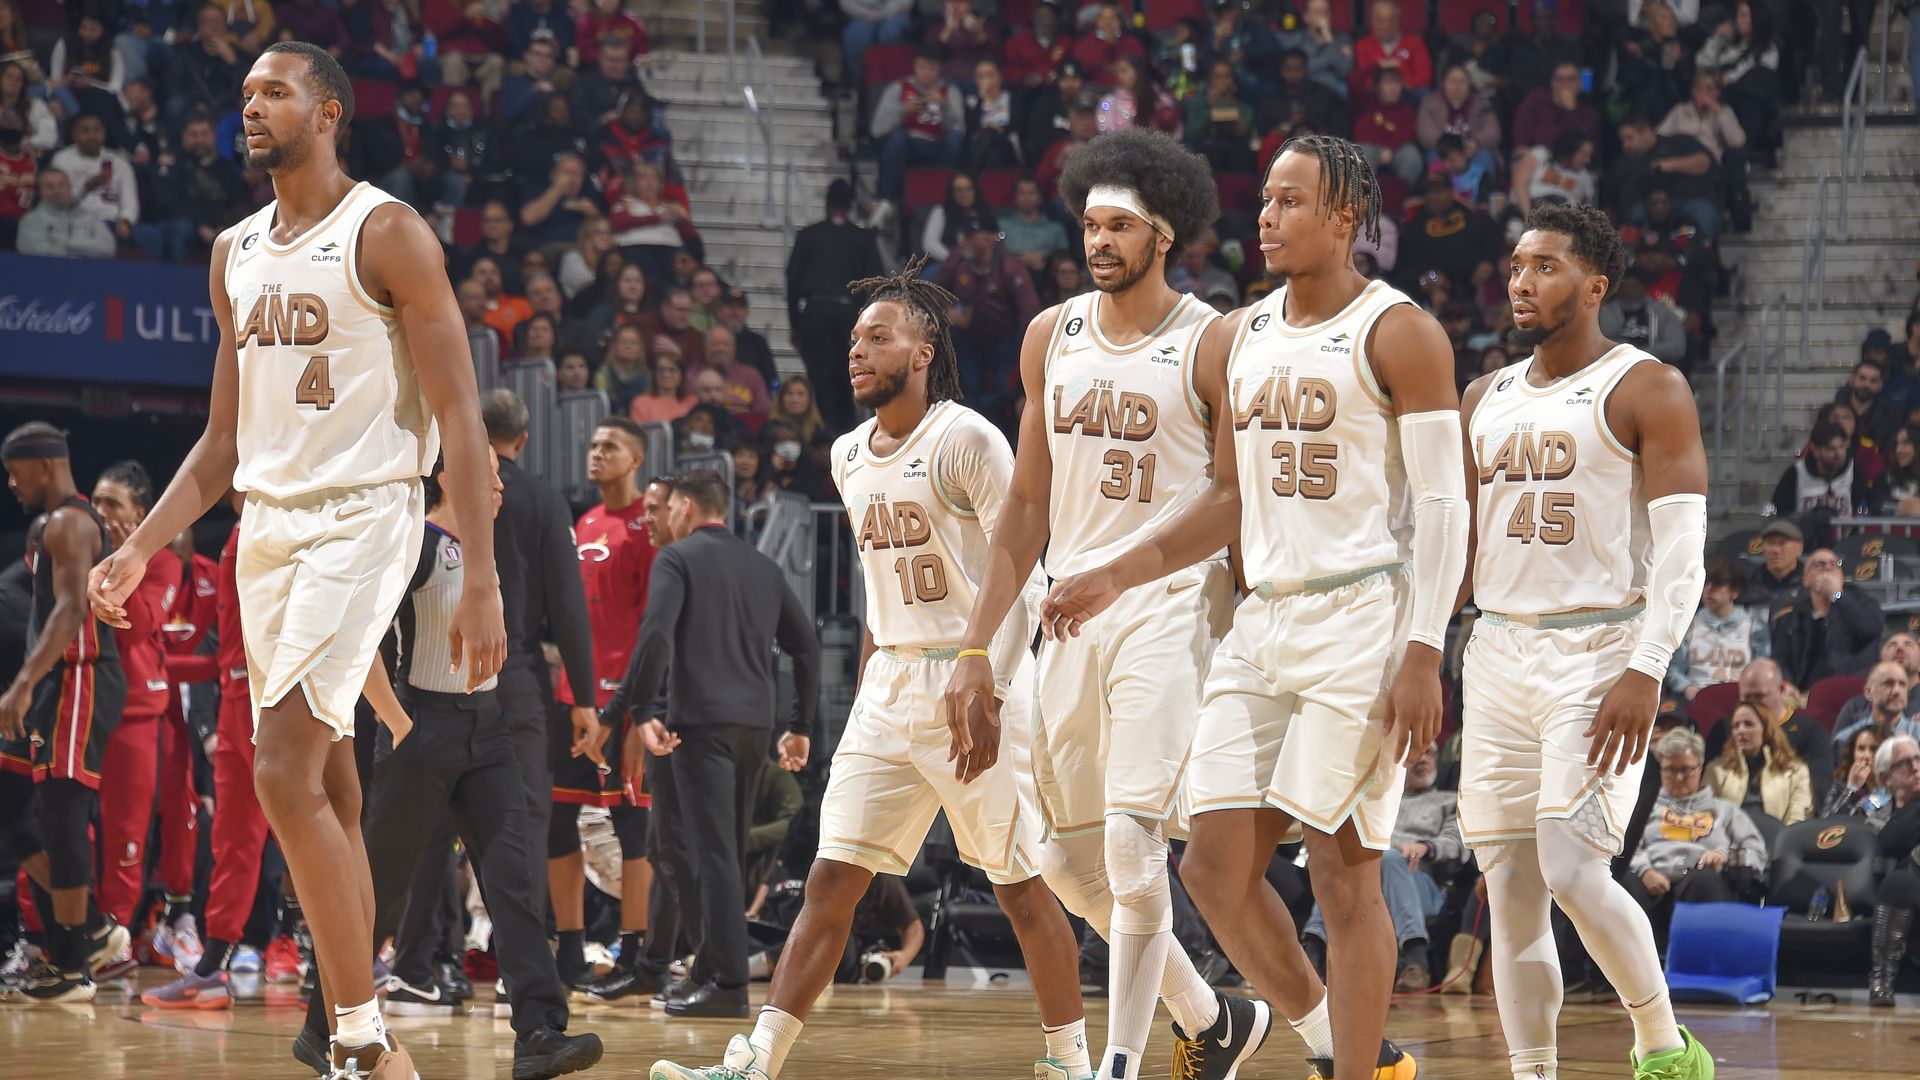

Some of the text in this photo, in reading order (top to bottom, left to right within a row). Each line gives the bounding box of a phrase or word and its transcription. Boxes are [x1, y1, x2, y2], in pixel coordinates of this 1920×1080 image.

[311, 255, 341, 263] CLIFFS
[262, 284, 282, 293] THE
[0, 295, 96, 335] ichelob
[1252, 314, 1269, 331] 6
[1066, 319, 1081, 335] 6
[1321, 345, 1350, 355] CLIFFS
[1151, 356, 1179, 366] CLIFFS
[1271, 366, 1292, 376] THE
[296, 356, 334, 410] 4
[1093, 378, 1114, 388] THE
[1053, 385, 1158, 441] LAND
[1233, 377, 1337, 432] LAND
[1514, 422, 1535, 431] THE
[1477, 431, 1577, 485] LAND
[1100, 449, 1156, 503] 31
[1271, 441, 1338, 500] 35
[869, 493, 886, 502] THE
[1507, 492, 1575, 545] 45
[895, 553, 948, 605] 10
